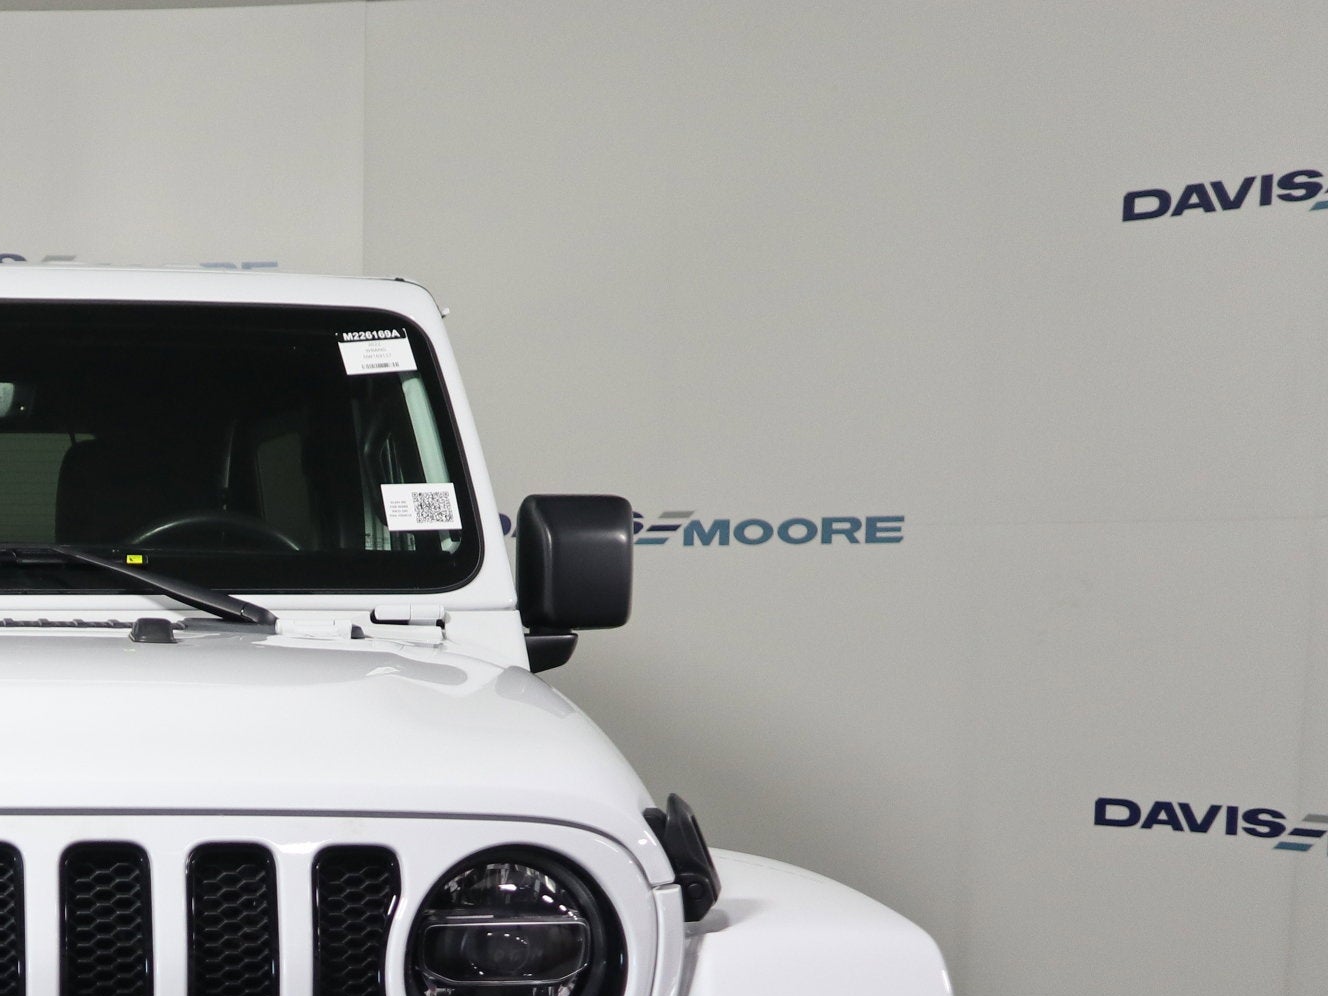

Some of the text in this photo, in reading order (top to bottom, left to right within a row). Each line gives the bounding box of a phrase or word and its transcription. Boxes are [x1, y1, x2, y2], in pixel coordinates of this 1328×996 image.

[1122, 169, 1323, 222] DAVIS
[683, 515, 904, 546] MOORE
[1094, 797, 1287, 838] DAVIS
